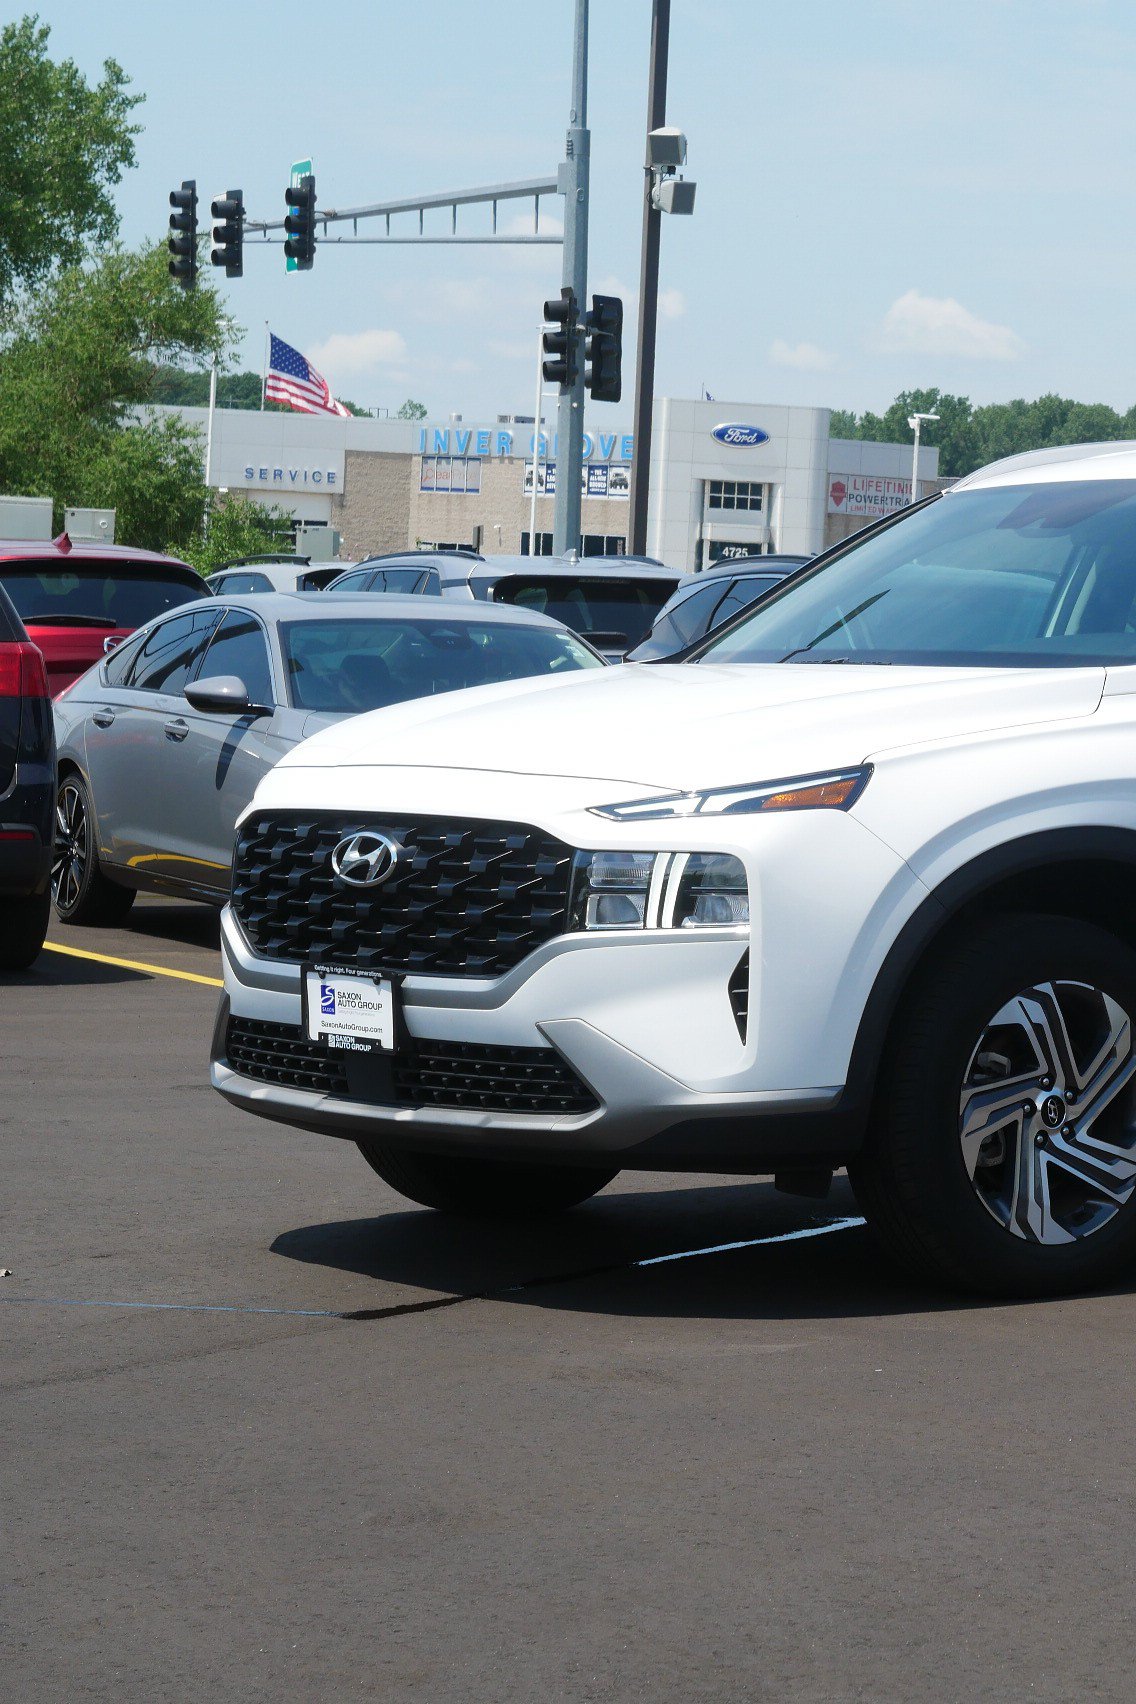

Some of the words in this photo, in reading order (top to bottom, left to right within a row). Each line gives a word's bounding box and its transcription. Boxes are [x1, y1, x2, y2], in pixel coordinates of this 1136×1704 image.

[419, 428, 513, 455] INVER
[724, 428, 758, 443] Ford
[245, 467, 336, 484] SERVICE
[848, 493, 910, 507] POWERTRA
[722, 546, 748, 558] 4725
[314, 964, 330, 973] Getting
[338, 991, 362, 1000] SAXON
[337, 1000, 356, 1008] AUTO
[357, 1001, 383, 1011] GROUP
[321, 1021, 383, 1033] SaxonAutoGroup.com
[336, 1035, 355, 1043] SAXON
[336, 1042, 351, 1050] AUTO
